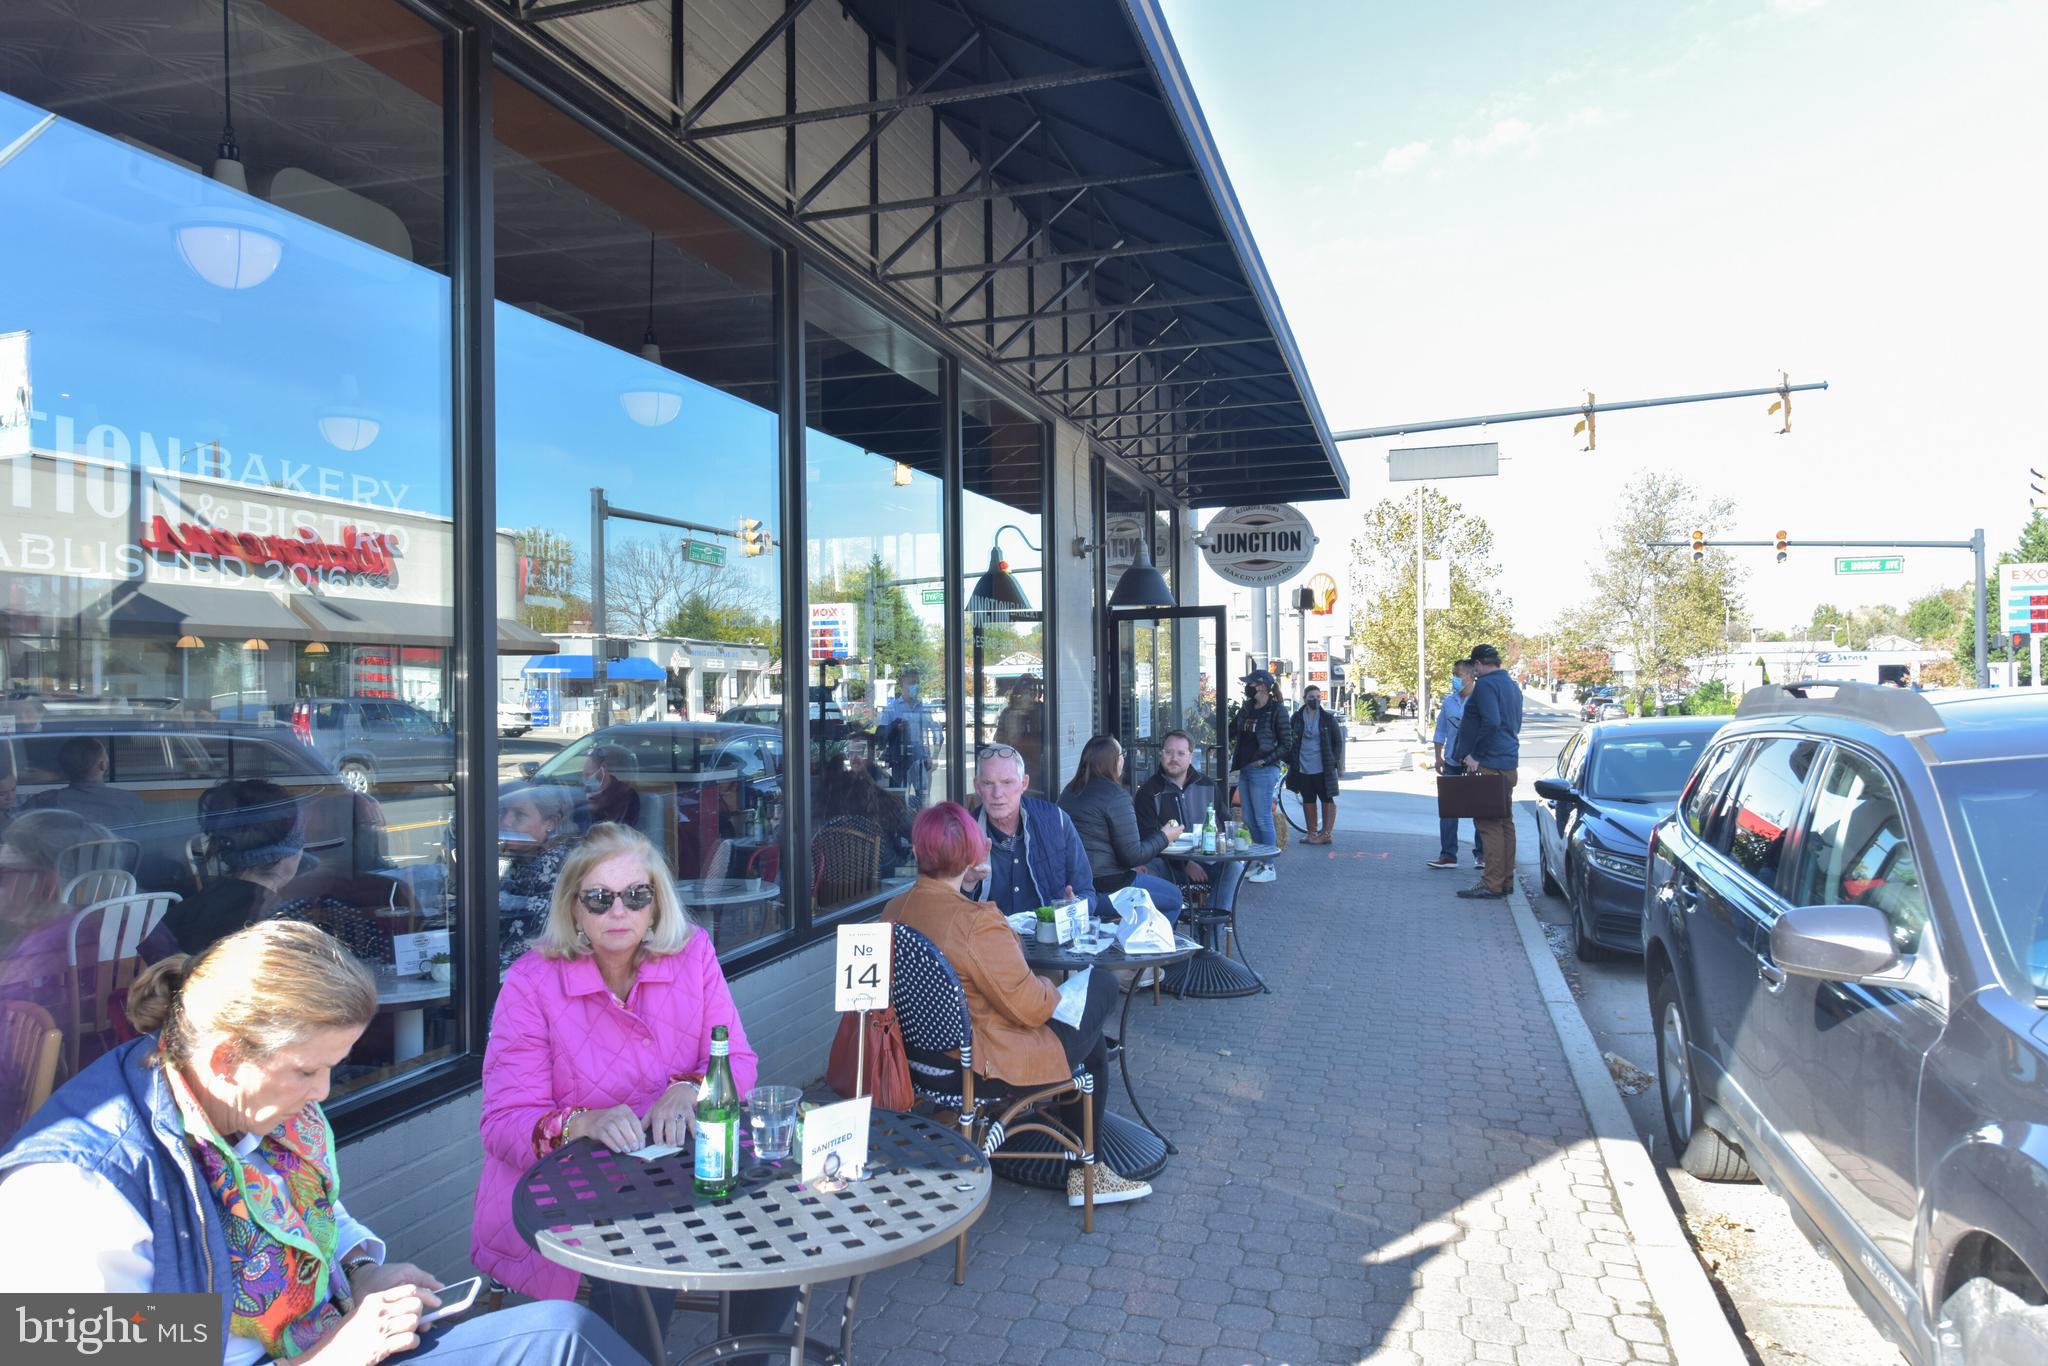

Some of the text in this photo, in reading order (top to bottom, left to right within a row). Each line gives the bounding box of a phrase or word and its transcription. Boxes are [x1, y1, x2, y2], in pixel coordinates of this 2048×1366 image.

[194, 441, 409, 511] BAKERY
[193, 493, 410, 556] & BISTRO
[1210, 530, 1302, 554] JUNCTION
[263, 558, 349, 594] 2016
[1224, 566, 1256, 582] BAKERY
[844, 963, 881, 989] 14
[811, 1132, 853, 1156] SANITIZED
